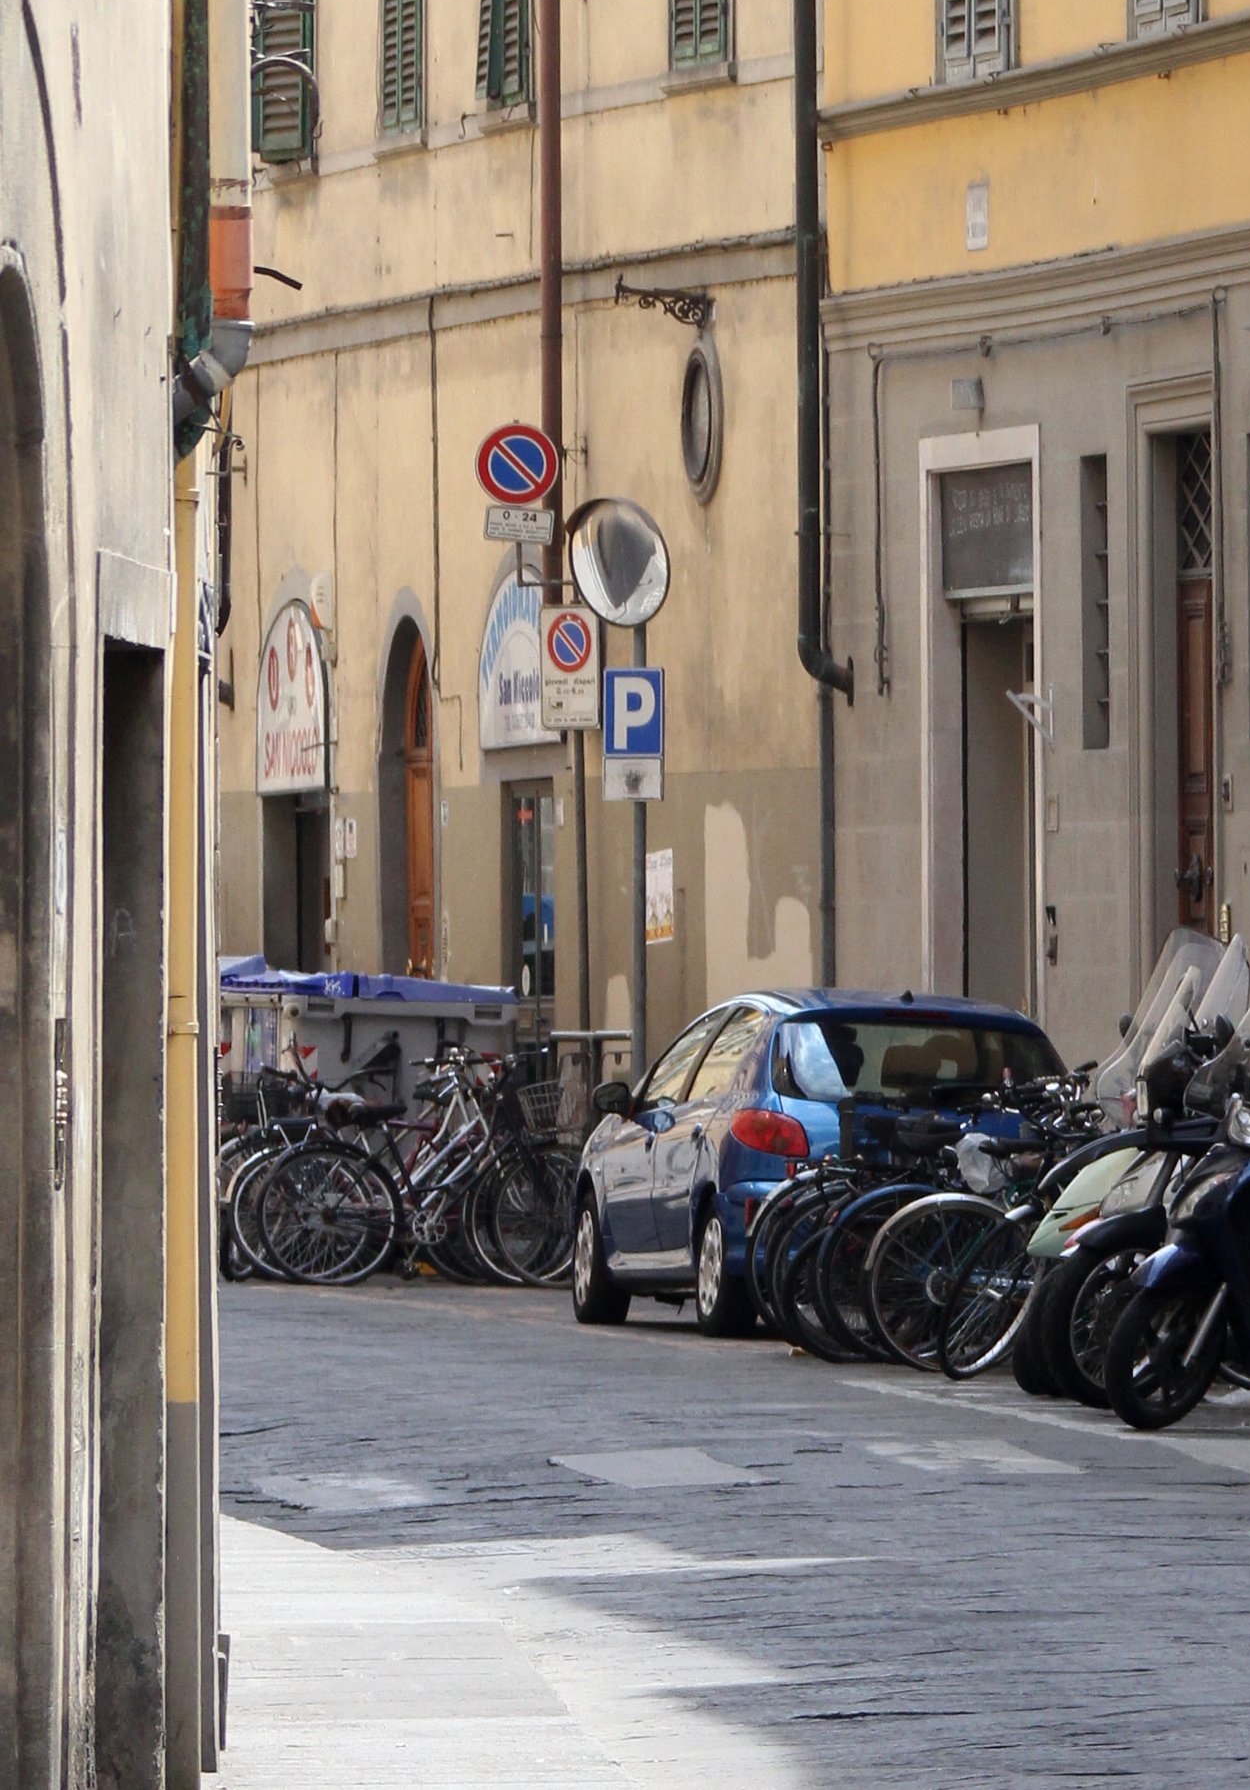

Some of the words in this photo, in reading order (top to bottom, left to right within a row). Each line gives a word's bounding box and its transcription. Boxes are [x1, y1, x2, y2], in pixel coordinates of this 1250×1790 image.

[502, 510, 511, 521] 0
[521, 512, 538, 523] 24
[499, 671, 512, 706] San
[613, 675, 656, 751] P
[264, 731, 282, 780] SAN
